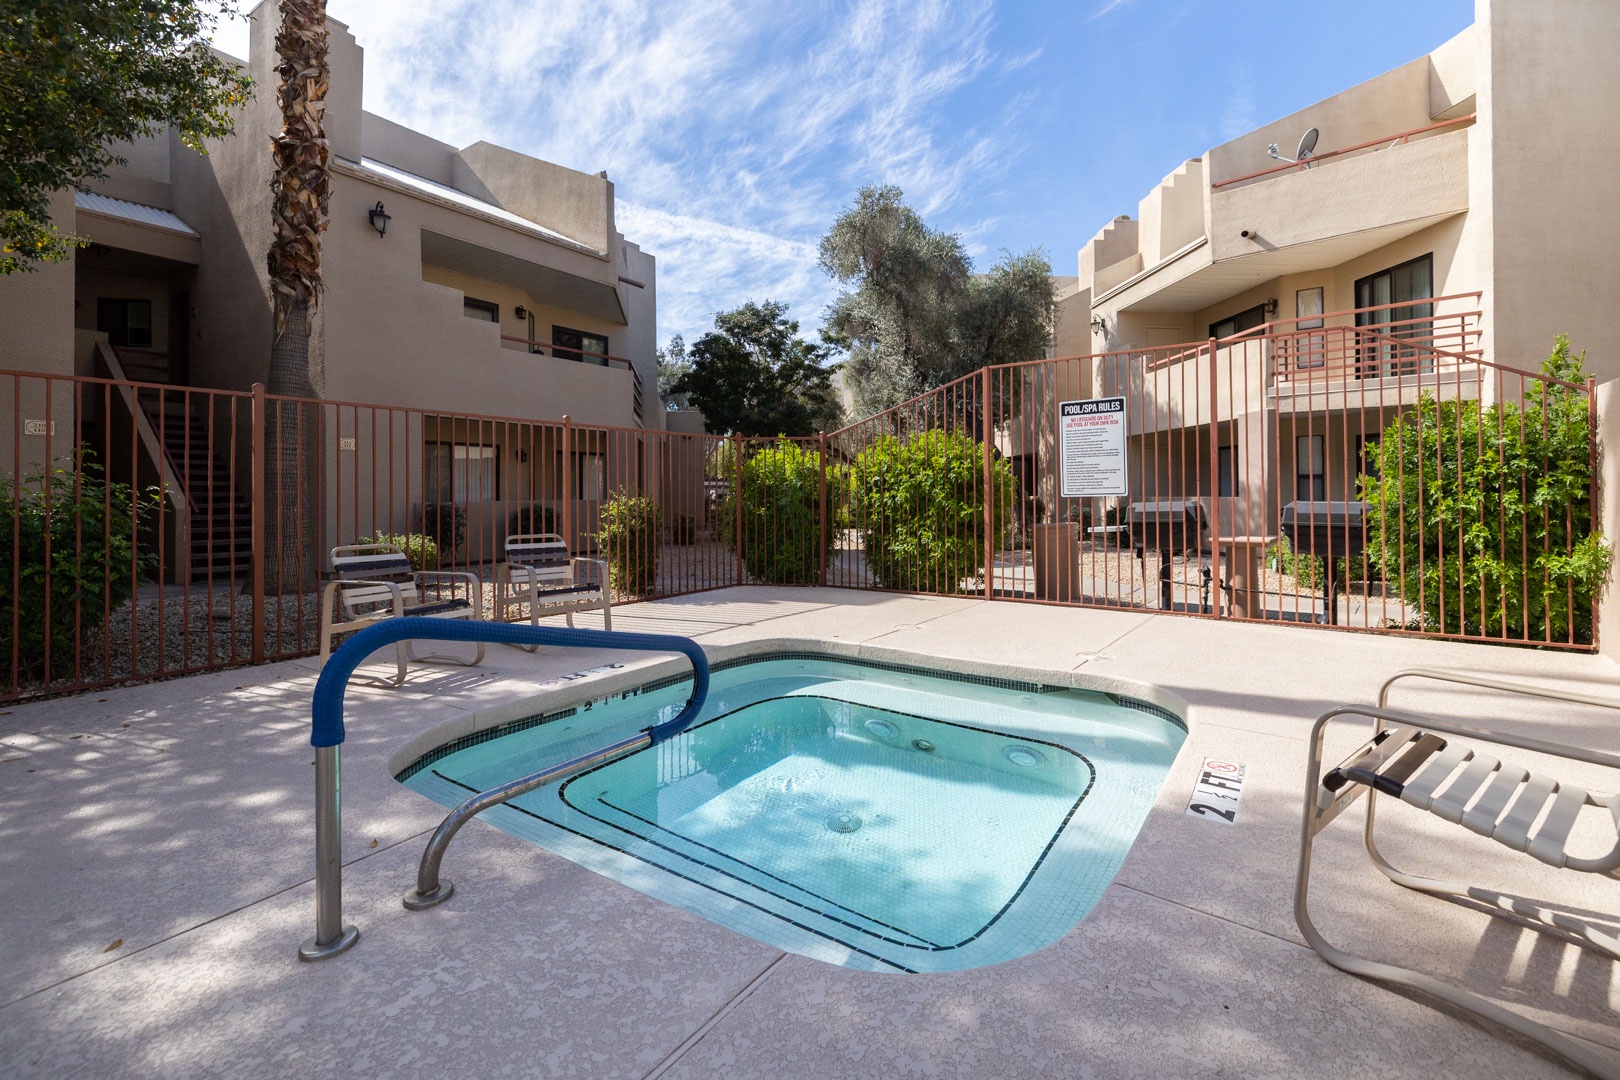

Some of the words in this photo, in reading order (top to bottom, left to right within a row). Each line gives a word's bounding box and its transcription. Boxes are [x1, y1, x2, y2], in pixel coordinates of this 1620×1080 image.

[1064, 404, 1097, 414] POOL/SPA
[1098, 401, 1120, 412] RULES
[584, 700, 593, 712] 2
[1200, 771, 1242, 792] FT
[1189, 803, 1236, 823] 2
